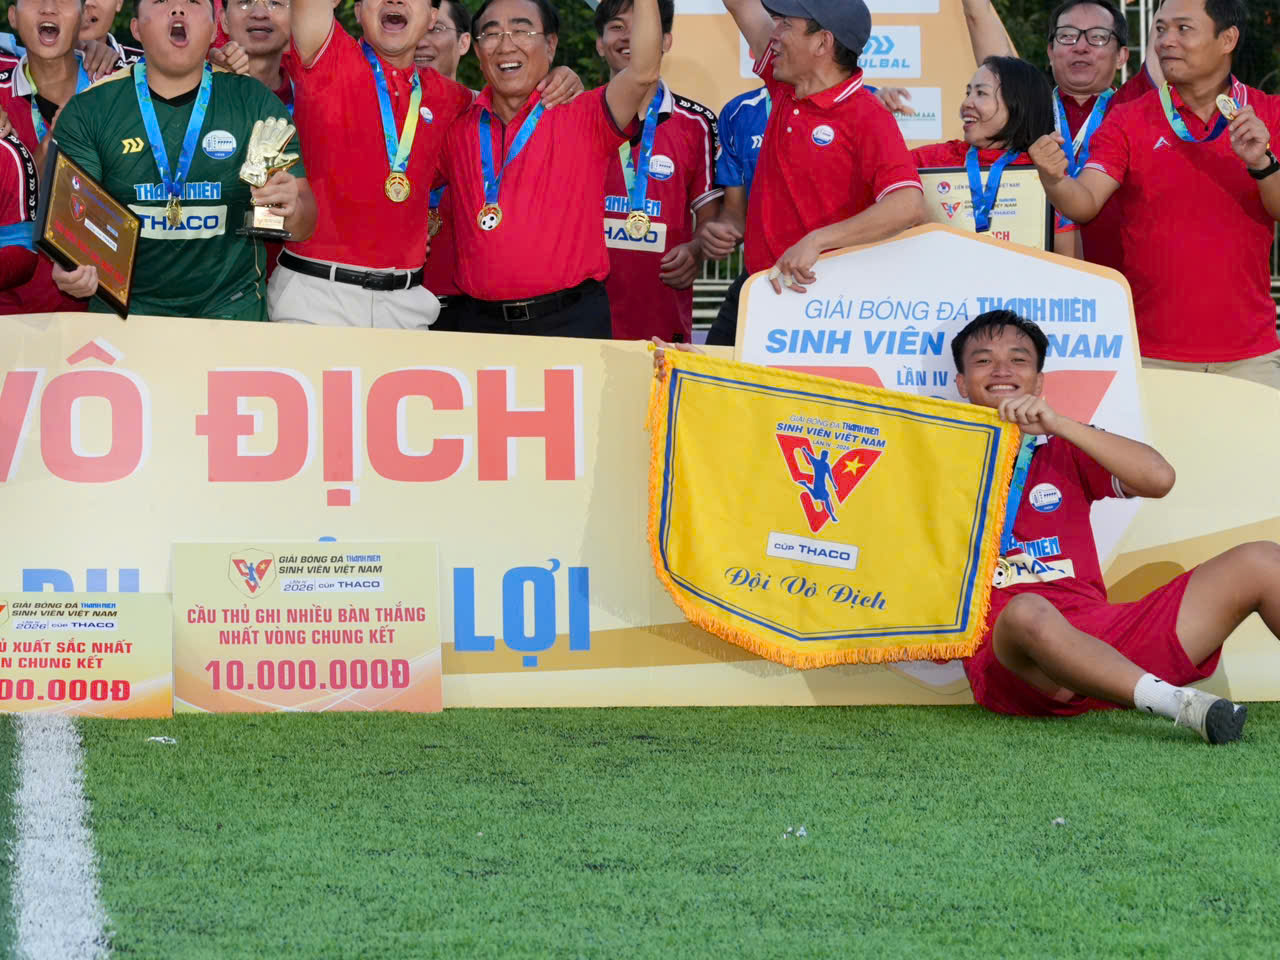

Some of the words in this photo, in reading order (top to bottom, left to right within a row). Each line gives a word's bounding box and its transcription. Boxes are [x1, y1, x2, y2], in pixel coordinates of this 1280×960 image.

[858, 57, 910, 68] ULBAL
[805, 295, 855, 319] GIẢI
[859, 296, 931, 321] BÓNG
[937, 297, 968, 321] ĐÁ
[766, 329, 850, 354] SINH
[864, 327, 943, 355] VIÊN
[1050, 334, 1123, 358] NAM
[896, 366, 922, 386] LẦN
[933, 370, 948, 386] IV
[196, 368, 576, 506] ĐỊCH
[776, 423, 803, 433] SINH
[806, 426, 832, 438] VIÊN
[835, 430, 859, 443] VIỆT
[861, 437, 886, 448] NAM
[799, 544, 850, 560] THACO
[724, 567, 771, 592] Đội
[780, 576, 817, 598] Vô
[827, 584, 887, 610] Địch
[187, 604, 216, 624] CẦU
[222, 604, 250, 623] THỦ
[256, 609, 281, 623] GHI
[287, 603, 332, 623] NHIỀU
[338, 605, 370, 622] BÀN
[375, 601, 426, 622] THẮNG
[452, 558, 590, 667] LỢI
[13, 639, 52, 653] XUẤT
[56, 638, 86, 654] SẮC
[92, 639, 133, 654] NHẤT
[219, 626, 260, 645] NHẤT
[265, 626, 306, 644] VÒNG
[312, 629, 363, 644] CHUNG
[369, 625, 395, 644] KẾT
[19, 657, 71, 669] CHUNG
[77, 655, 104, 669] KẾT
[205, 659, 410, 690] 10.000.000Đ
